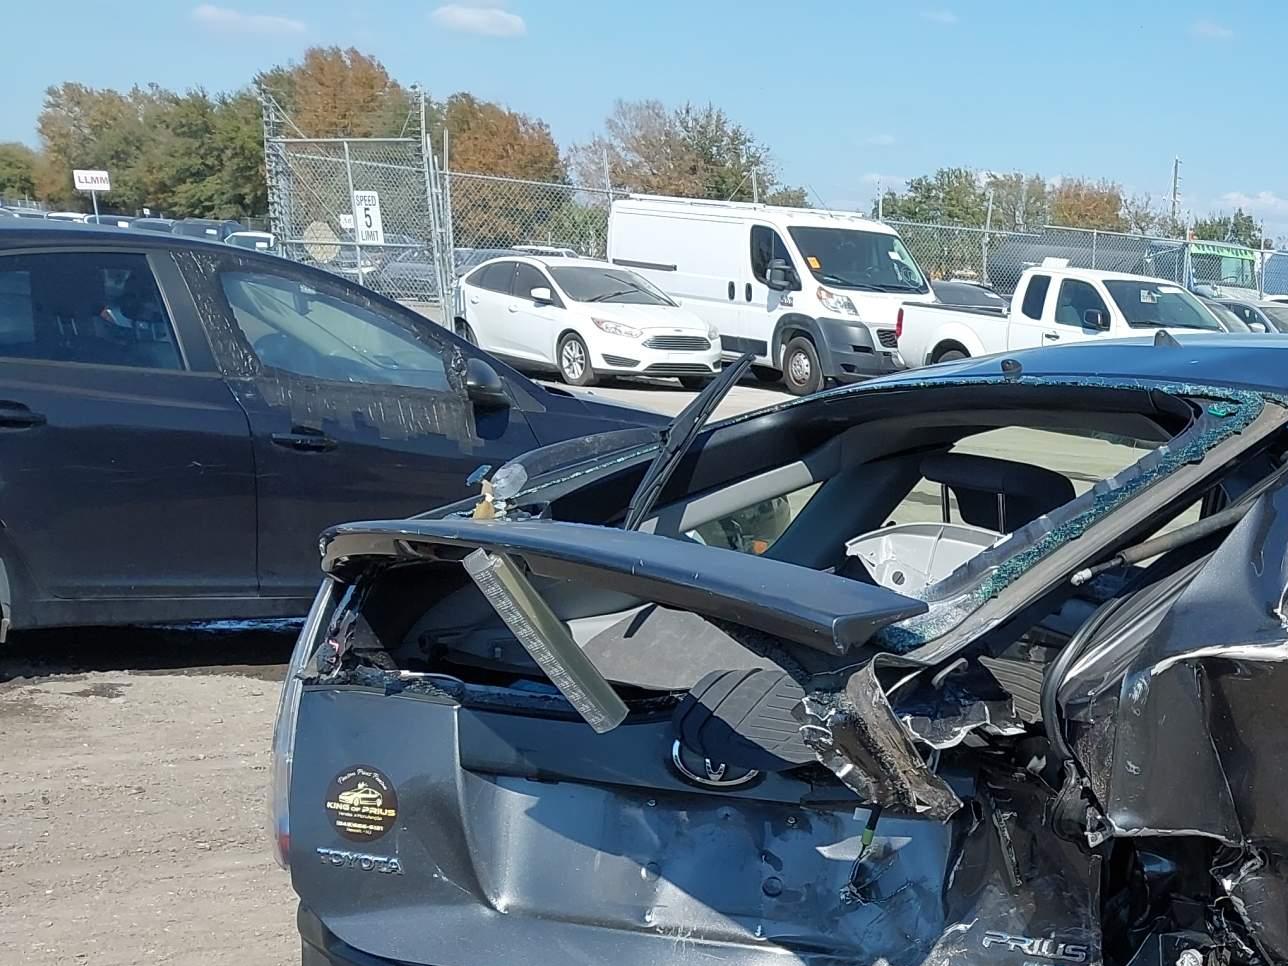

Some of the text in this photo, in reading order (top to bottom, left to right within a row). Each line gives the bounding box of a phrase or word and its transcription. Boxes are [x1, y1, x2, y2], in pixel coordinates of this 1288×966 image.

[77, 175, 109, 185] LLMM
[355, 194, 377, 207] SPEED
[363, 207, 373, 228] 5
[360, 230, 379, 242] LIMIT
[326, 801, 350, 811] KING
[361, 806, 396, 817] PRIUS
[316, 847, 405, 876] TOYOTA
[981, 930, 1089, 963] PRIUS
